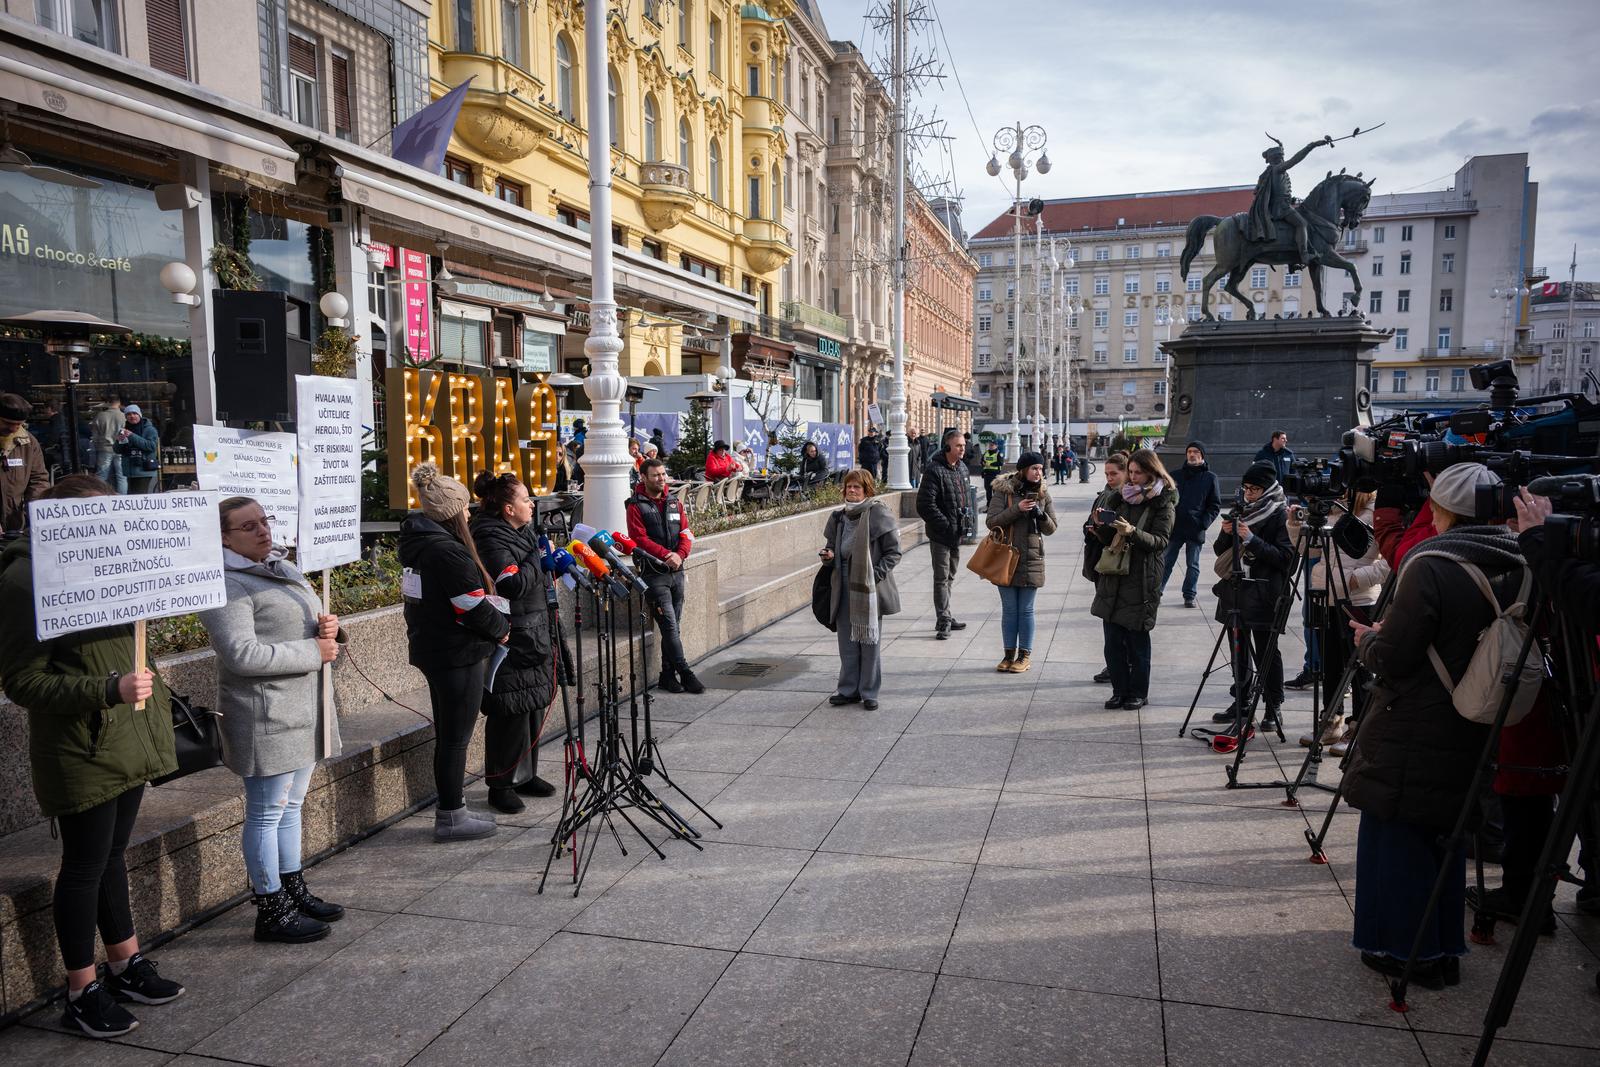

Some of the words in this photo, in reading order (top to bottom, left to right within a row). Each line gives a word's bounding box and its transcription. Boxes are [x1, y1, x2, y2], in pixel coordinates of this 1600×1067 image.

[35, 244, 85, 265] choco
[87, 252, 98, 267] &
[100, 258, 131, 272] café
[819, 337, 841, 358] DOUGLAS
[315, 393, 335, 404] HVALA
[337, 393, 353, 405] VAM,
[342, 423, 352, 434] ŠTO
[246, 440, 264, 448] KOLIKO
[390, 367, 557, 510] KRAŠ
[314, 444, 324, 453] STE
[326, 444, 353, 453] RISKIRALI
[234, 454, 253, 462] DANAS
[323, 459, 340, 470] ŽIVOT
[341, 460, 349, 468] DA
[314, 474, 338, 486] ZAŠTITE
[339, 475, 356, 485] DJECU.
[218, 486, 256, 494] POKAZUJEMO
[260, 487, 278, 495] KOLIKO
[36, 503, 69, 520] NAŠA
[73, 502, 107, 517] DJECA
[112, 497, 167, 512] ZASLUŽUJU
[172, 496, 208, 508] SRETNA
[314, 505, 328, 516] VAŠA
[329, 504, 357, 515] HRABROST
[314, 520, 331, 530] NIKAD
[332, 517, 347, 528] NEĆE
[348, 518, 357, 527] BITI
[41, 525, 96, 542] SJEĆANJA
[100, 523, 116, 535] NA
[124, 518, 159, 532] ĐAČKO
[161, 519, 191, 532] DOBA,
[314, 534, 356, 545] ZABORAVLJENA.
[58, 545, 122, 564] ISPUNJENA
[127, 538, 186, 551] OSMIJEHOM
[188, 537, 191, 547] I
[94, 556, 173, 577] BEZBRIŽNOŠĆU.
[42, 589, 95, 608] NEĆEMO
[101, 580, 156, 599] DOPUSTITI
[159, 577, 172, 589] DA
[175, 574, 185, 585] SE
[187, 569, 222, 584] OVAKVA
[42, 610, 108, 631] TRAGEDIJA
[112, 604, 145, 620] IKADA
[146, 599, 167, 613] VIŠE
[171, 594, 208, 608] PONOVI
